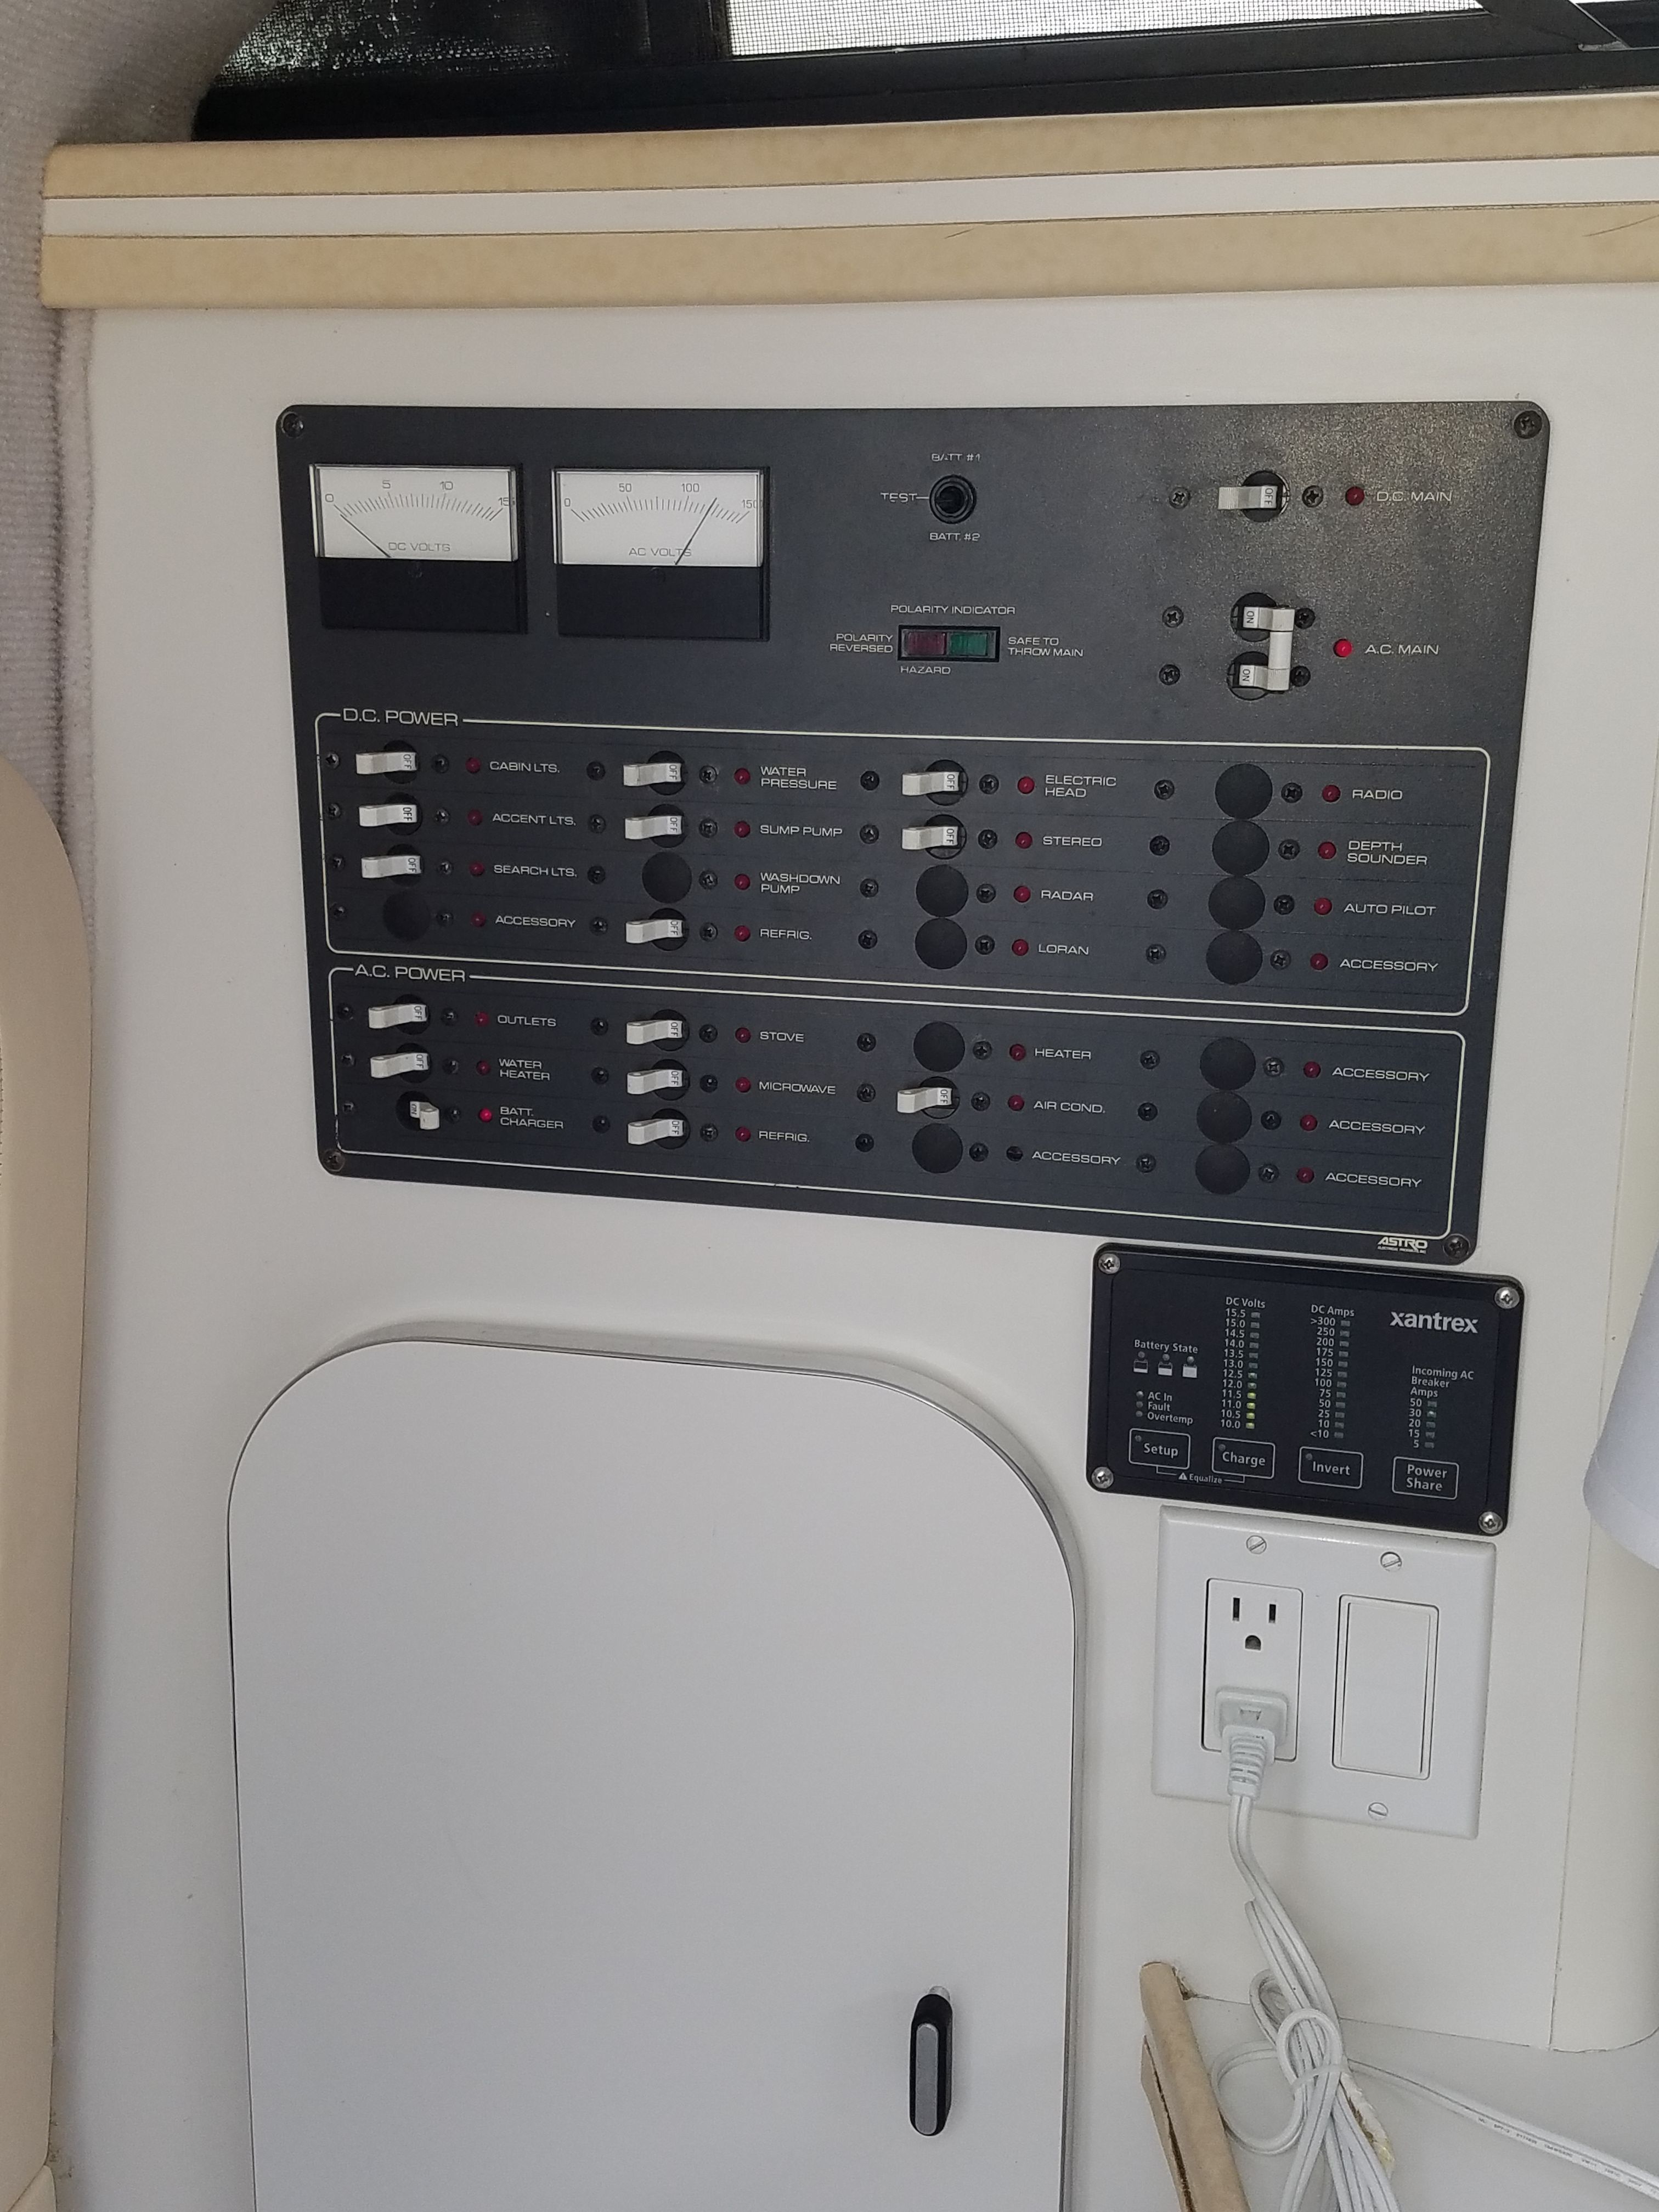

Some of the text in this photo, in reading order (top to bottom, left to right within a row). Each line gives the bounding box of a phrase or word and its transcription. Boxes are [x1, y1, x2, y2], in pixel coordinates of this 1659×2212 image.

[382, 480, 391, 488] 5
[440, 481, 453, 490] 10
[619, 483, 631, 492] 50
[682, 483, 699, 492] 100
[325, 494, 334, 502] 0
[881, 493, 917, 503] TEST
[1265, 487, 1273, 506] OFF
[1377, 492, 1452, 501] D.C. MAIN
[565, 498, 571, 506] 0
[410, 543, 450, 551] VOLTS
[650, 548, 692, 557] VOLTS
[1246, 611, 1254, 624] ON
[837, 634, 893, 642] POLARITY
[830, 644, 893, 652] REVERSED
[1365, 645, 1438, 654] A.C. MAIN
[1242, 668, 1250, 682] ON
[343, 708, 458, 726] D.C. POWER
[403, 754, 412, 770] OFF
[490, 761, 559, 772] CABIN LTS.
[668, 764, 677, 780] OFF
[761, 767, 806, 776] WATER
[761, 778, 837, 789] PRESSURE
[1046, 775, 1116, 786] ELECTRIC
[1046, 788, 1086, 797] HEAD
[1353, 790, 1402, 799] RADIO
[402, 807, 412, 822] OFF
[493, 814, 575, 825] ACCENT LTS.
[669, 817, 678, 833] OFF
[760, 825, 842, 836] SUMP PUMP
[1043, 837, 1102, 846] STEREO
[1349, 841, 1402, 851] DEPTH
[1347, 853, 1427, 865] SOUNDER
[408, 857, 417, 873] OFF
[494, 865, 577, 877] SEARCH LTS.
[761, 873, 840, 884] WASHDOWN
[761, 884, 799, 893] PUMP
[1042, 890, 1093, 901] RADAR
[1344, 904, 1436, 915] AUTO PILOT
[495, 916, 575, 927] ACCESSORY
[670, 920, 679, 936] OFF
[760, 929, 811, 939] REFRIG.
[1039, 944, 1088, 955] LORAN
[1340, 959, 1438, 971] ACCESSORY
[355, 964, 465, 981] A.C. POWER
[498, 1015, 556, 1026] OUTLETS
[670, 1022, 679, 1037] OFF
[760, 1032, 803, 1042] STOVE
[1035, 1048, 1091, 1059] HEATER
[416, 1054, 424, 1069] OFF
[499, 1059, 541, 1069] WATER
[500, 1070, 550, 1080] HEATER
[671, 1071, 679, 1086] OFF
[1332, 1068, 1429, 1081] ACCESSORY
[760, 1082, 836, 1094] MICROWAVE
[940, 1088, 949, 1104] OFF
[500, 1107, 533, 1116] BATT.
[1034, 1101, 1105, 1113] AIR COND.
[500, 1118, 563, 1128] CHARGER
[672, 1120, 680, 1136] OFF
[1329, 1120, 1425, 1135] ACCESSORY
[759, 1131, 809, 1142] REFRIG.
[1032, 1152, 1121, 1165] ACCESSORY
[1325, 1173, 1421, 1187] ACCESSORY
[1378, 1237, 1427, 1253] ASTRO
[1226, 1297, 1265, 1308] DC Volts
[1226, 1308, 1245, 1317] 15.5
[1312, 1305, 1355, 1318] DC Amps
[1226, 1318, 1245, 1328] 15.0
[1390, 1312, 1477, 1333] xantrex
[1225, 1329, 1244, 1338] 14.5
[1317, 1327, 1334, 1336] 250
[1135, 1340, 1198, 1353] Battery State
[1225, 1339, 1244, 1348] 14.0
[1317, 1338, 1334, 1346] 200
[1224, 1348, 1243, 1358] 13.5
[1317, 1347, 1333, 1356] 175
[1224, 1359, 1243, 1368] 13.0
[1316, 1358, 1333, 1367] 150
[1223, 1369, 1242, 1378] 12.5
[1316, 1368, 1331, 1377] 125
[1412, 1365, 1474, 1380] Incoming AC
[1223, 1379, 1242, 1388] 12.0
[1316, 1378, 1331, 1387] 100
[1411, 1376, 1449, 1388] Breaker
[1148, 1392, 1172, 1401] AC In
[1223, 1389, 1241, 1398] 11.5
[1320, 1389, 1330, 1397] 75
[1410, 1387, 1438, 1399] Amps
[1148, 1402, 1170, 1411] Fault
[1222, 1400, 1241, 1408] 11.0
[1319, 1399, 1330, 1408] 50
[1410, 1398, 1421, 1407] 50
[1222, 1409, 1240, 1418] 10.5
[1318, 1409, 1329, 1418] 25
[1409, 1408, 1421, 1417] 30
[1148, 1412, 1193, 1425] Overtemp
[1221, 1419, 1240, 1428] 10.0
[1319, 1419, 1329, 1427] 10
[1409, 1419, 1420, 1427] 20
[1409, 1429, 1419, 1437] 15
[1144, 1443, 1178, 1458] Setup
[1223, 1452, 1265, 1467] Charge
[1313, 1462, 1350, 1475] Invert
[1407, 1464, 1447, 1480] Power
[1189, 1474, 1222, 1483] Equalize
[1407, 1477, 1442, 1491] Share
